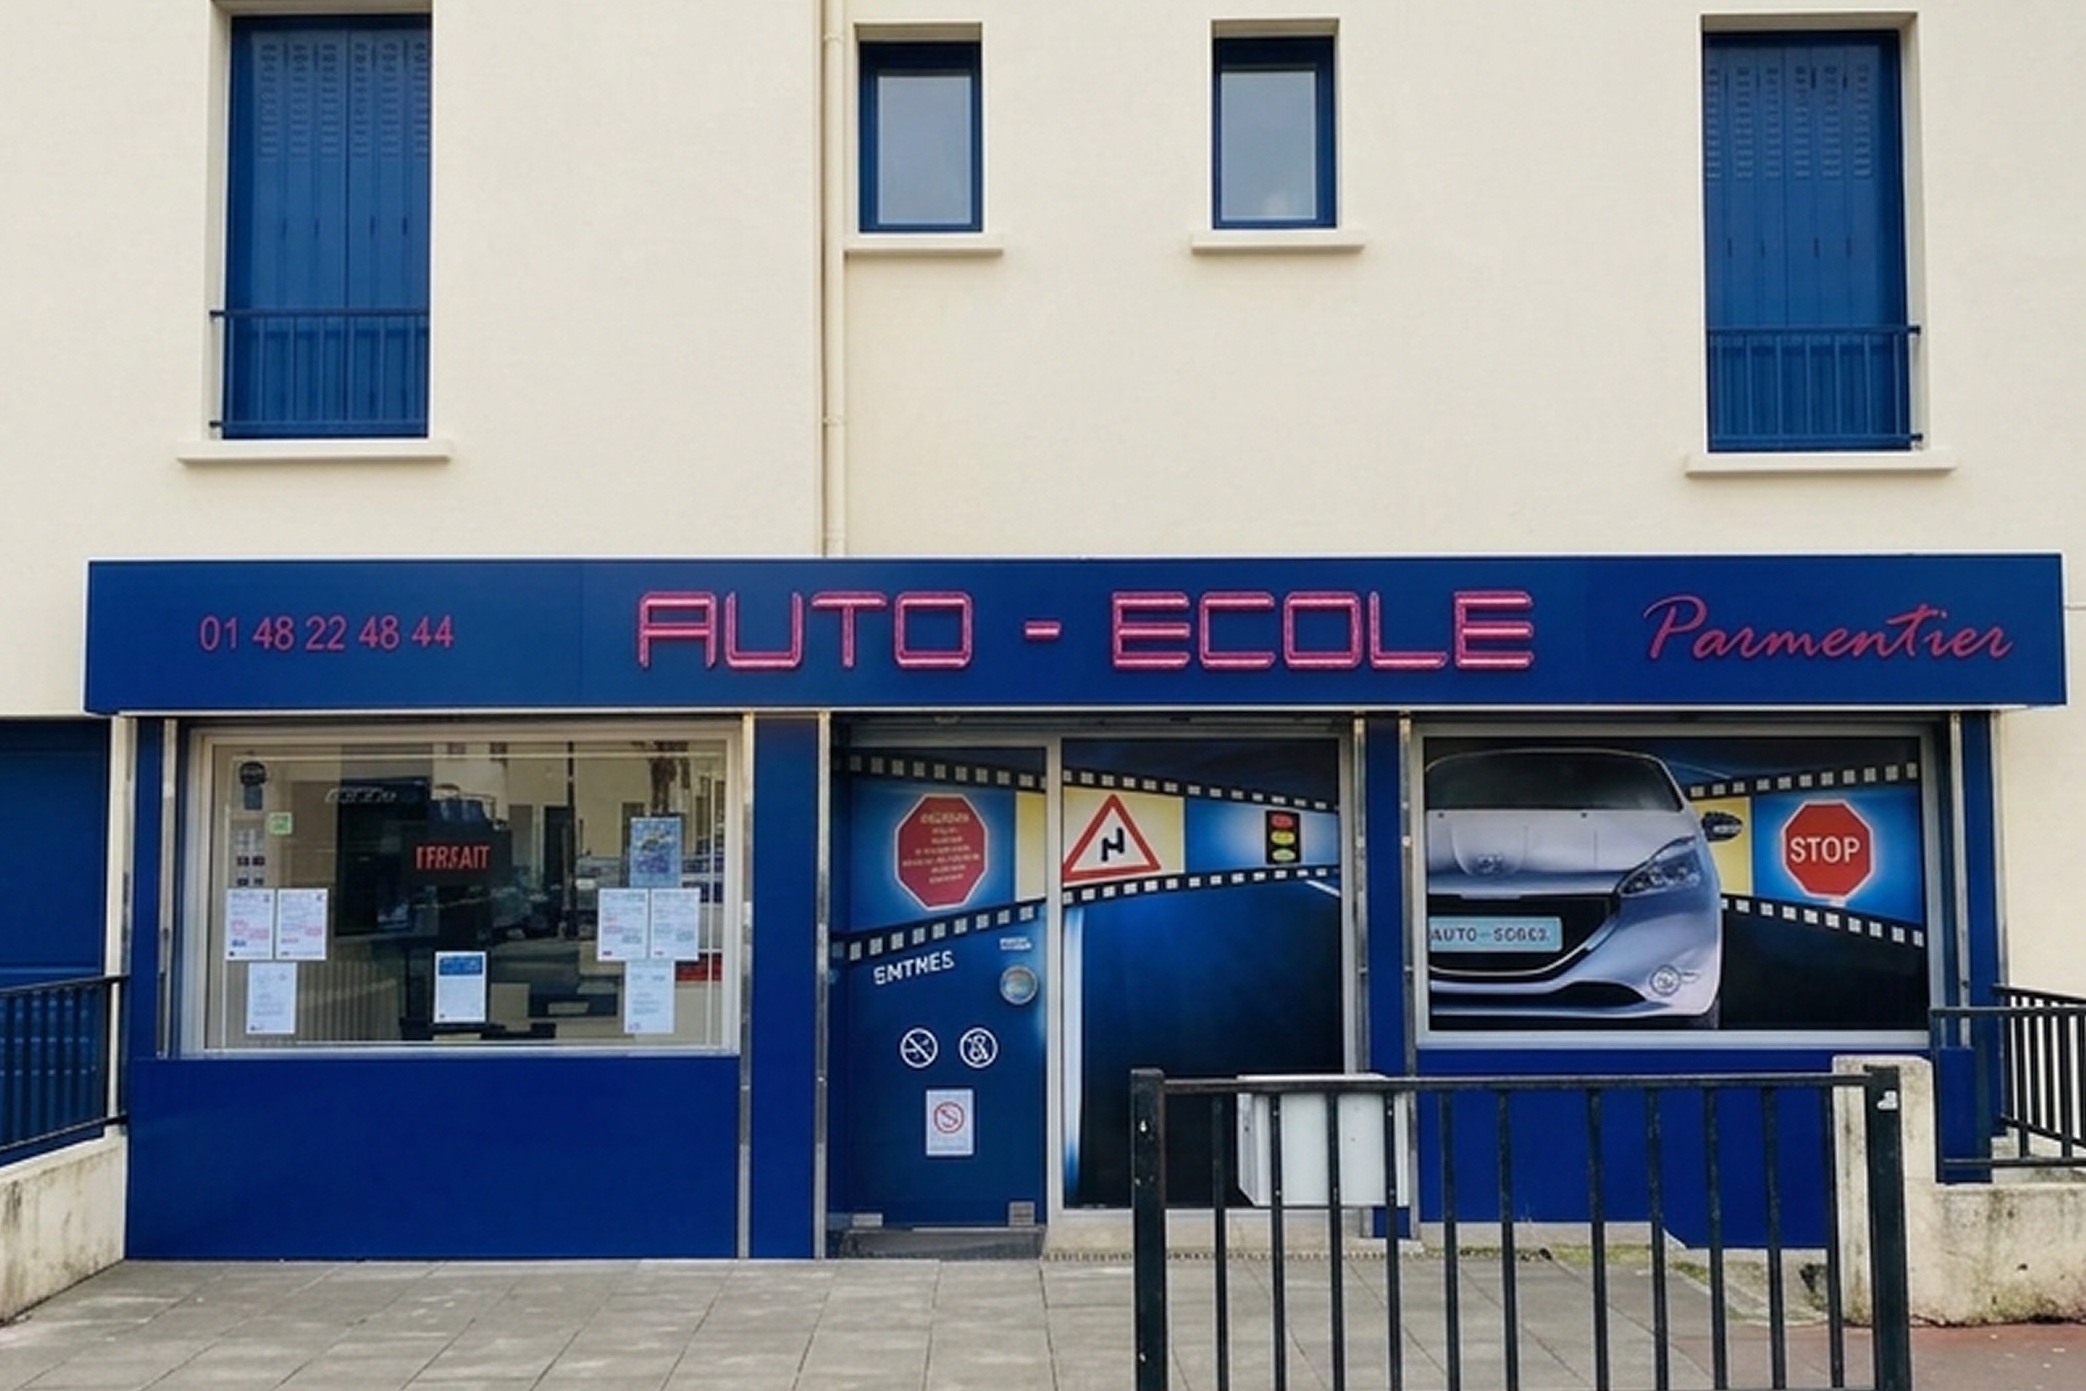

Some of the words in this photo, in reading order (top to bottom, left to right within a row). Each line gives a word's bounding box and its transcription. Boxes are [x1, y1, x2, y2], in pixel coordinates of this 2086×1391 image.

[200, 615, 237, 651] 01
[252, 615, 294, 650] 48
[305, 614, 347, 650] 22
[358, 614, 400, 650] 48
[411, 614, 453, 648] 44
[638, 590, 973, 669] AUTO
[1024, 620, 1062, 640] -
[1111, 590, 1534, 669] ECOLE
[1643, 593, 2014, 660] Parmentier
[1790, 836, 1861, 863] STOP
[1429, 927, 1477, 942] AUTO
